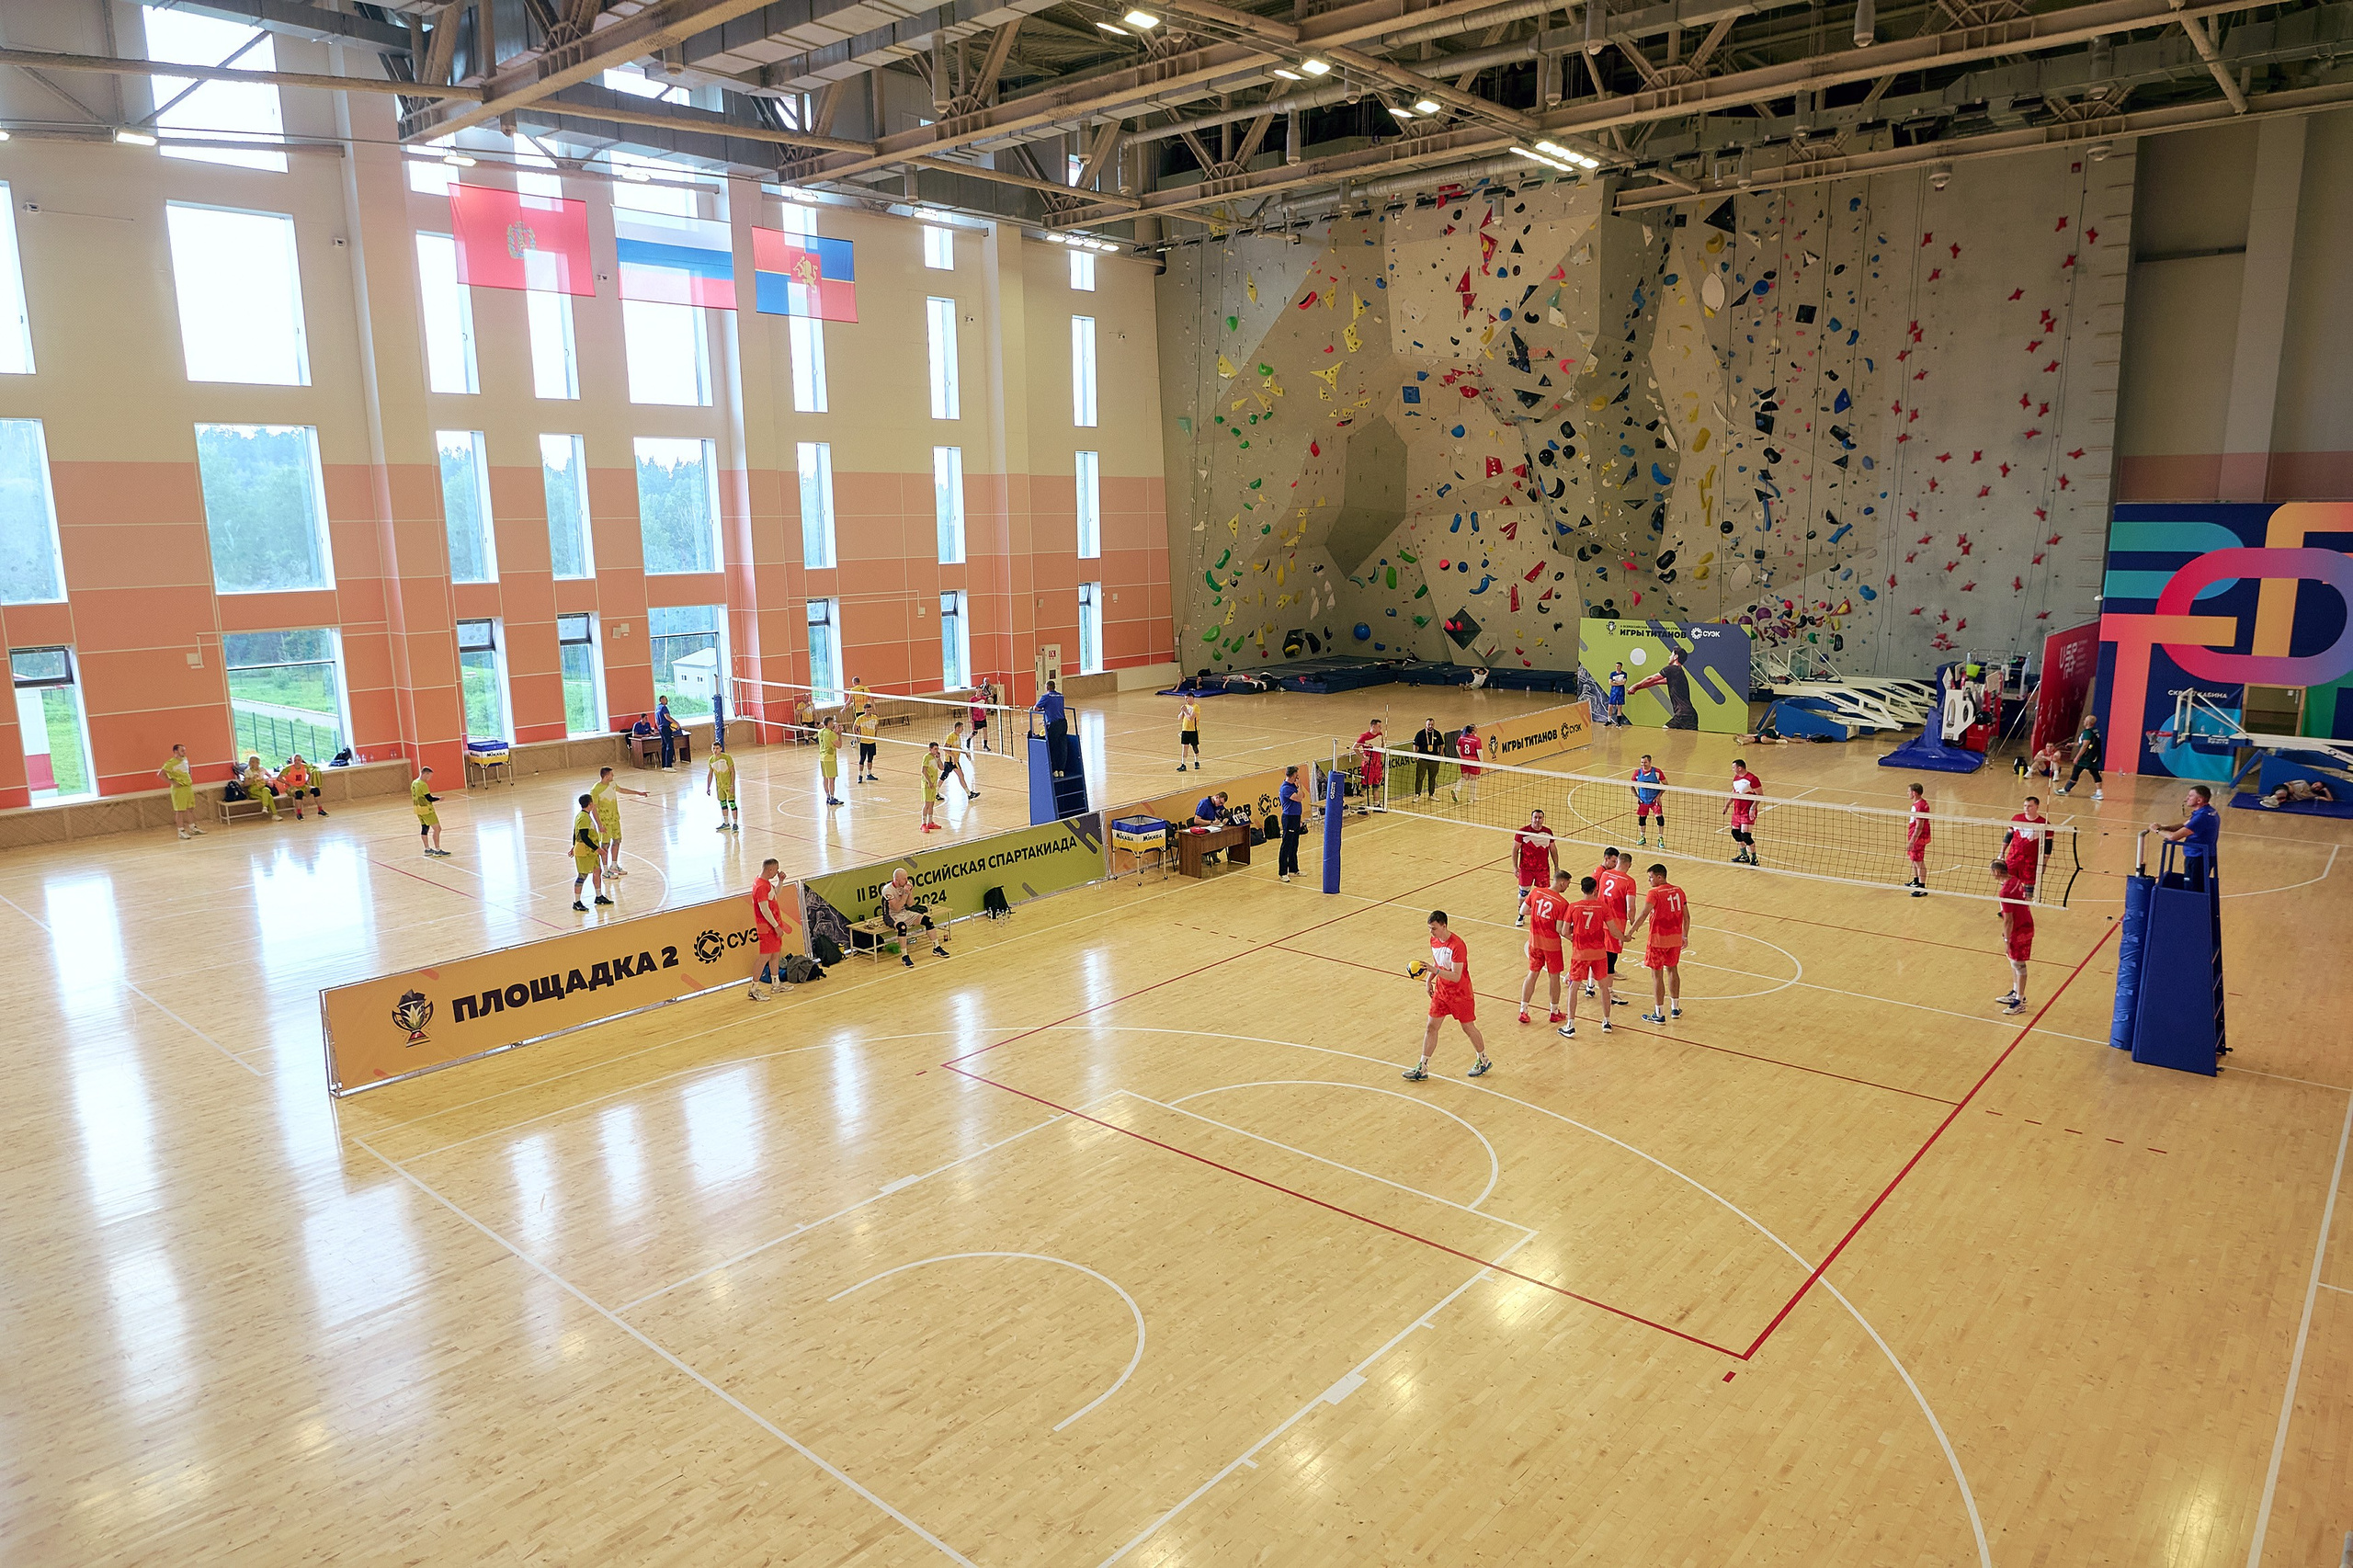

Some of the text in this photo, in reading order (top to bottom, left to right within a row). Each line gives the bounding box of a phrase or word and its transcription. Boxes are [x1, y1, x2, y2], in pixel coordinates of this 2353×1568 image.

[1620, 629, 1688, 639] ИГРЫ ТИТАНОВ
[1569, 722, 1583, 734] СУЭК
[1464, 744, 1471, 755] 8
[1501, 729, 1559, 754] ИГРЫ ТИТАНОВ
[988, 835, 1078, 869] СПАРТАКИАДА
[1603, 879, 1615, 897] 2
[1536, 898, 1553, 919] 12
[1666, 893, 1682, 913] 11
[1582, 911, 1594, 930] 7
[726, 927, 760, 949] СУЭ
[451, 945, 680, 1023] ПЛОЩАДКА 2
